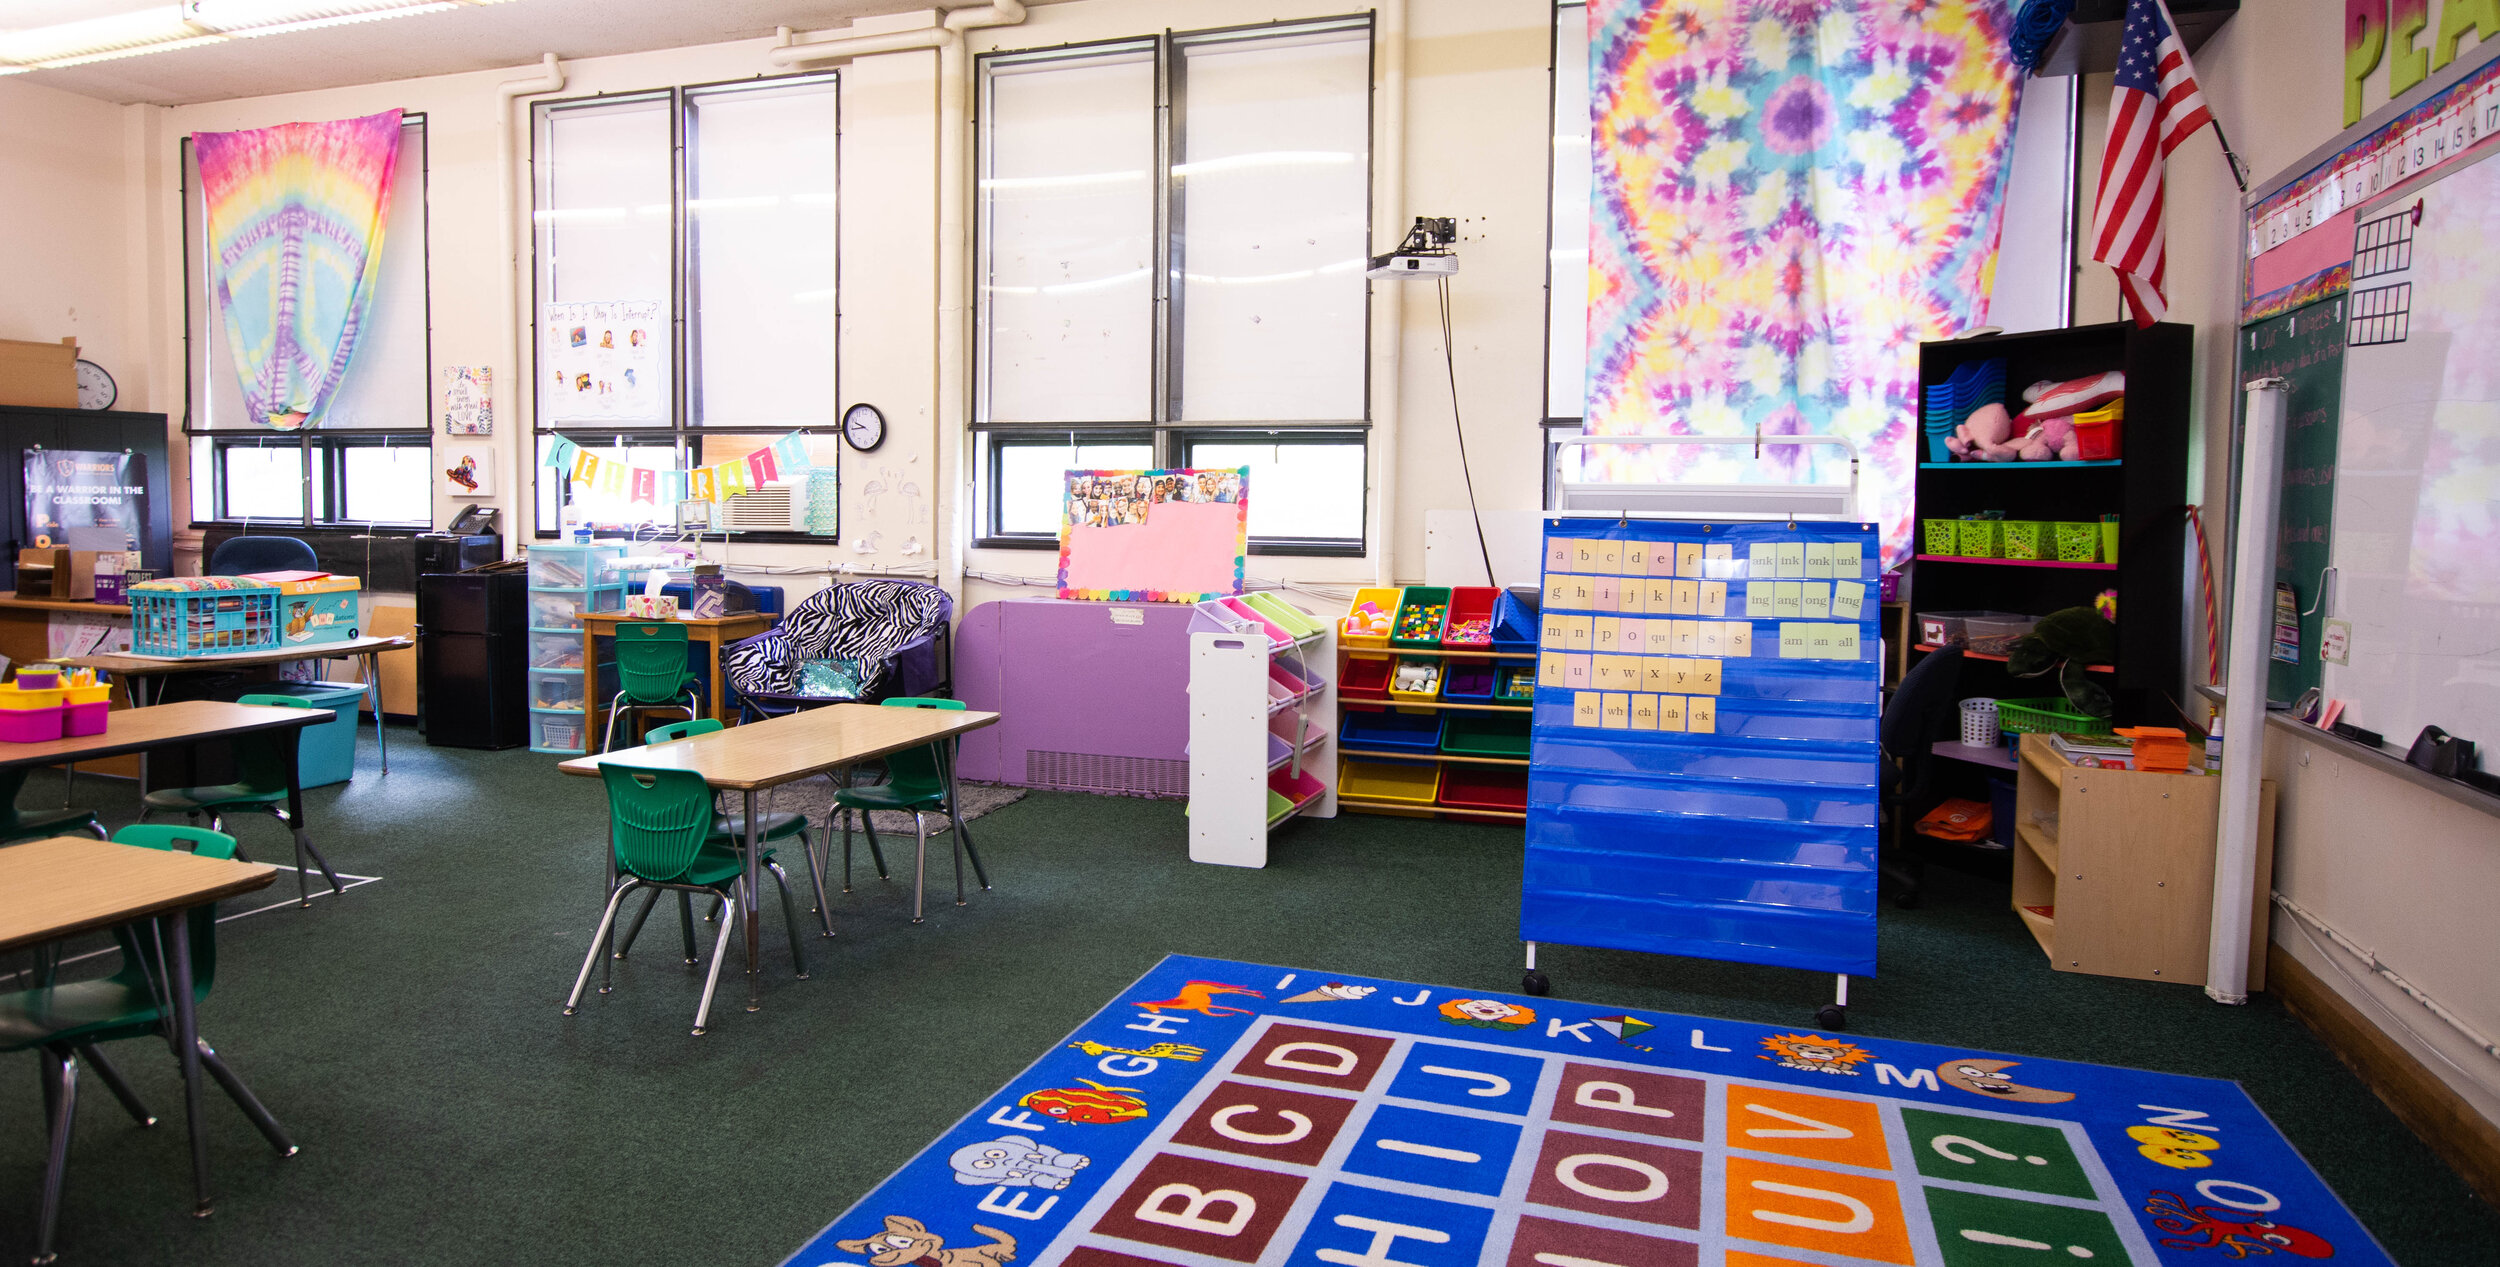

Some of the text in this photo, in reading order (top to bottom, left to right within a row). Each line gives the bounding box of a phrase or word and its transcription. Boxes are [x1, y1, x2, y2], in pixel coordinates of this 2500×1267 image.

[2271, 229, 2276, 244] 2
[2283, 223, 2288, 238] 3
[2295, 217, 2300, 232] 4
[2305, 210, 2313, 226] 5
[2356, 182, 2362, 200] 9
[2371, 173, 2378, 193] 10
[2397, 155, 2405, 177] 12
[2413, 147, 2424, 168] 13
[2434, 137, 2445, 159] 14
[2453, 126, 2463, 150] 15
[2469, 117, 2476, 140] 16
[2486, 104, 2499, 130] 17
[549, 305, 565, 321] When
[76, 463, 115, 472] WARRIORS
[556, 438, 804, 499] CELEBRATE
[30, 485, 144, 494] BE A WARRIOR IN THE
[53, 496, 122, 505] CLASSROOM!
[1556, 552, 1564, 560] a
[1581, 550, 1589, 561] b
[1632, 552, 1641, 563] d
[1657, 555, 1665, 564] e
[1687, 554, 1694, 565] f
[1752, 556, 1858, 566] ank ink onk unk
[127, 572, 153, 583] COOLEST
[1552, 587, 1561, 599] g
[1577, 586, 1586, 598] h
[1604, 588, 1609, 598] i
[1628, 590, 1634, 603] j
[1654, 590, 1663, 601] k
[1752, 595, 1860, 608] ing ang ong ung
[1547, 626, 1561, 636] m
[1575, 628, 1584, 638] n
[1602, 629, 1612, 641] p
[1628, 631, 1637, 640] o
[1651, 633, 1665, 643] qu
[1681, 632, 1688, 641] r
[1707, 634, 1715, 643] s
[1784, 637, 1853, 647] am an all
[1550, 664, 1712, 684] t u v w x y z
[1580, 704, 1709, 721] sh wh ch th ck
[1125, 1013, 1189, 1034] H
[1393, 989, 1431, 1006] J
[1546, 1018, 1592, 1042] K
[1690, 1029, 1732, 1052] L
[1874, 1062, 1939, 1092] M
[1098, 1054, 1159, 1077] G
[1264, 1041, 1358, 1076] D
[1421, 1064, 1511, 1097] J
[1575, 1081, 1674, 1118] P
[987, 1105, 1045, 1131] F
[1210, 1104, 1313, 1144] C
[1745, 1103, 1854, 1138] V
[2137, 1104, 2219, 1131] N
[1931, 1134, 2048, 1165] ?
[1555, 1154, 1669, 1202] O
[977, 1185, 1059, 1220] E
[1751, 1180, 1874, 1234] U
[2196, 1179, 2280, 1212] O
[1135, 1183, 1256, 1237] B
